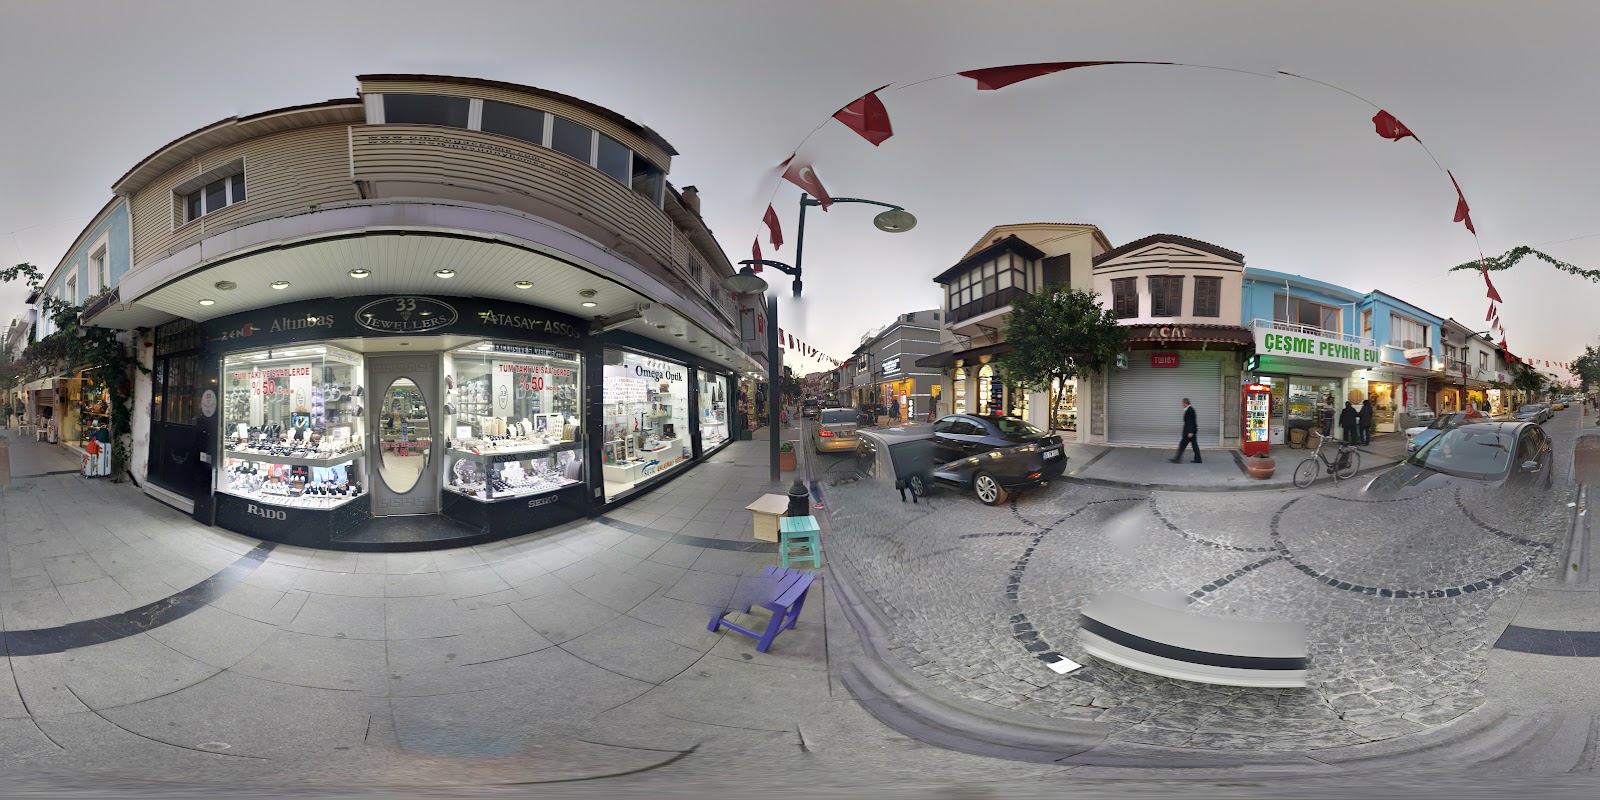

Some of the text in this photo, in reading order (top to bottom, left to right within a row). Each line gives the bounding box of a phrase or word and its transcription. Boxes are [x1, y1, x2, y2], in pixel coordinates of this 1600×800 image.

[396, 299, 416, 311] 33
[270, 313, 334, 333] Altınbaş
[366, 315, 446, 330] JEWELLERS
[481, 310, 534, 330] ATASAY
[544, 321, 580, 339] ASSOS
[494, 343, 527, 354] EXCLUSIVE
[528, 345, 546, 355] SILVER
[1265, 334, 1379, 363] ÇEŞME PEYNİR EVİ
[262, 369, 270, 378] VE
[532, 365, 539, 374] VE
[636, 365, 683, 384] Omega Optik
[492, 454, 517, 463] ASSOS
[528, 495, 558, 508] SEIKO
[247, 504, 286, 521] RADO
